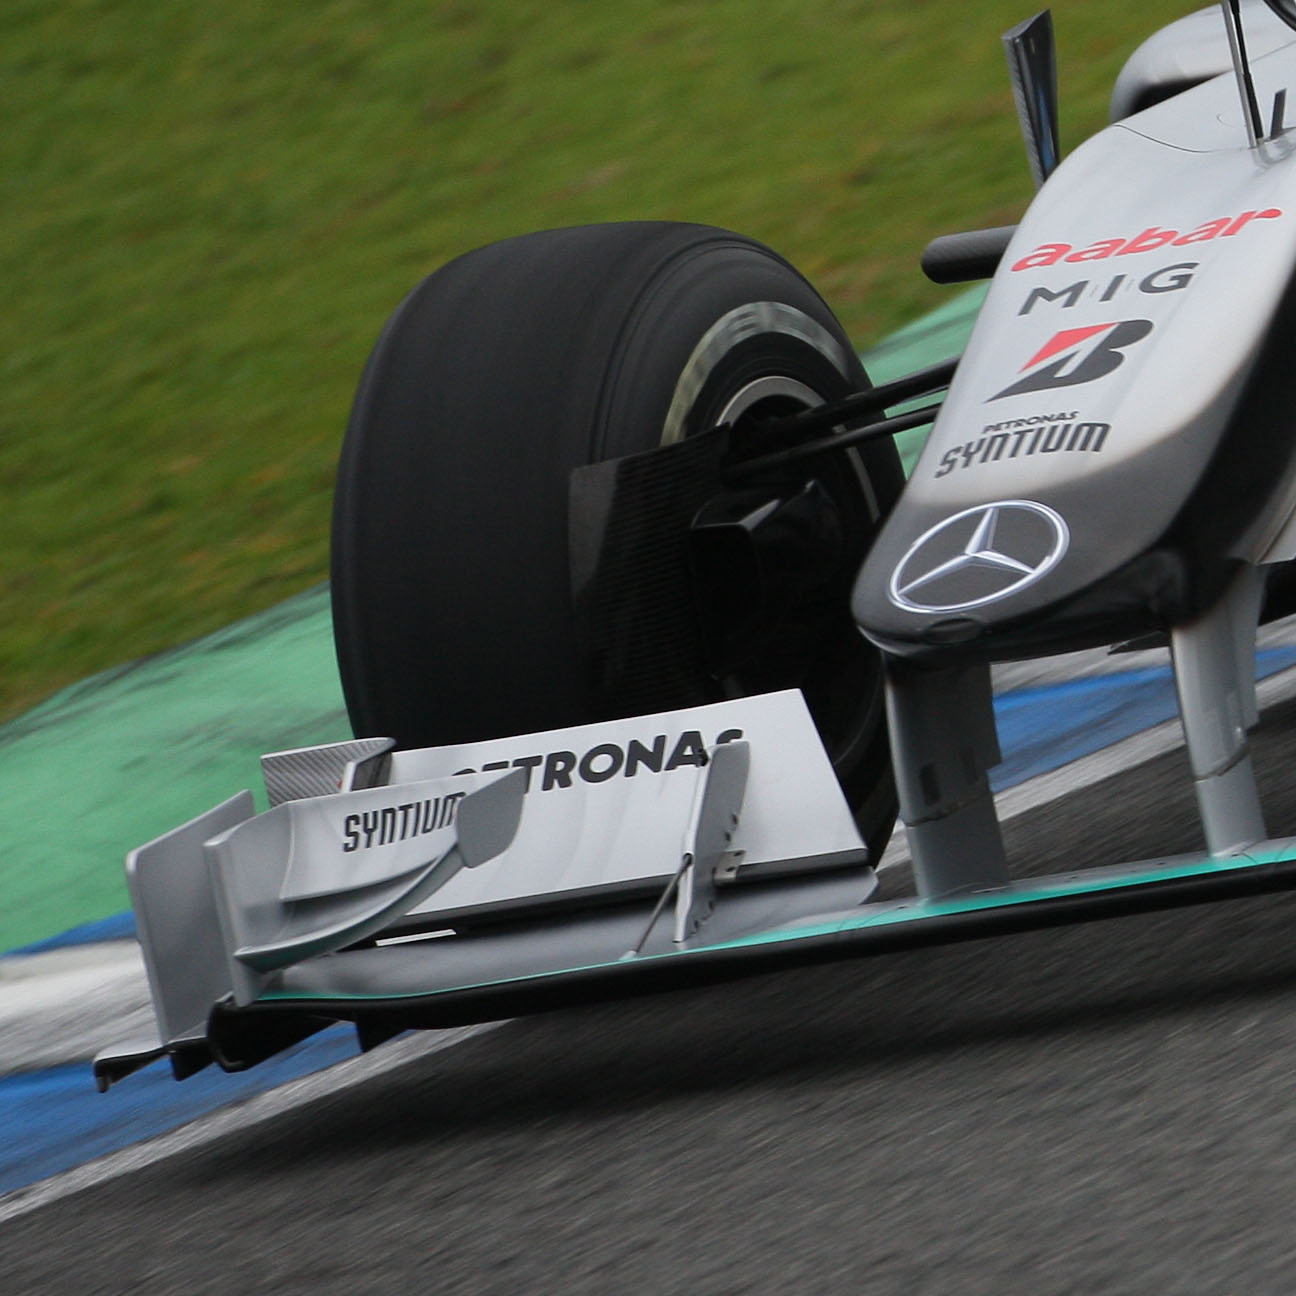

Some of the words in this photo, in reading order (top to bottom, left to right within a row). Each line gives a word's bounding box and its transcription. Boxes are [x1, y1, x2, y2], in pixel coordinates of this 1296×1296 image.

[1010, 207, 1283, 272] aabar
[934, 422, 1112, 479] SYNTIUM
[982, 410, 1080, 435] PETRONAS
